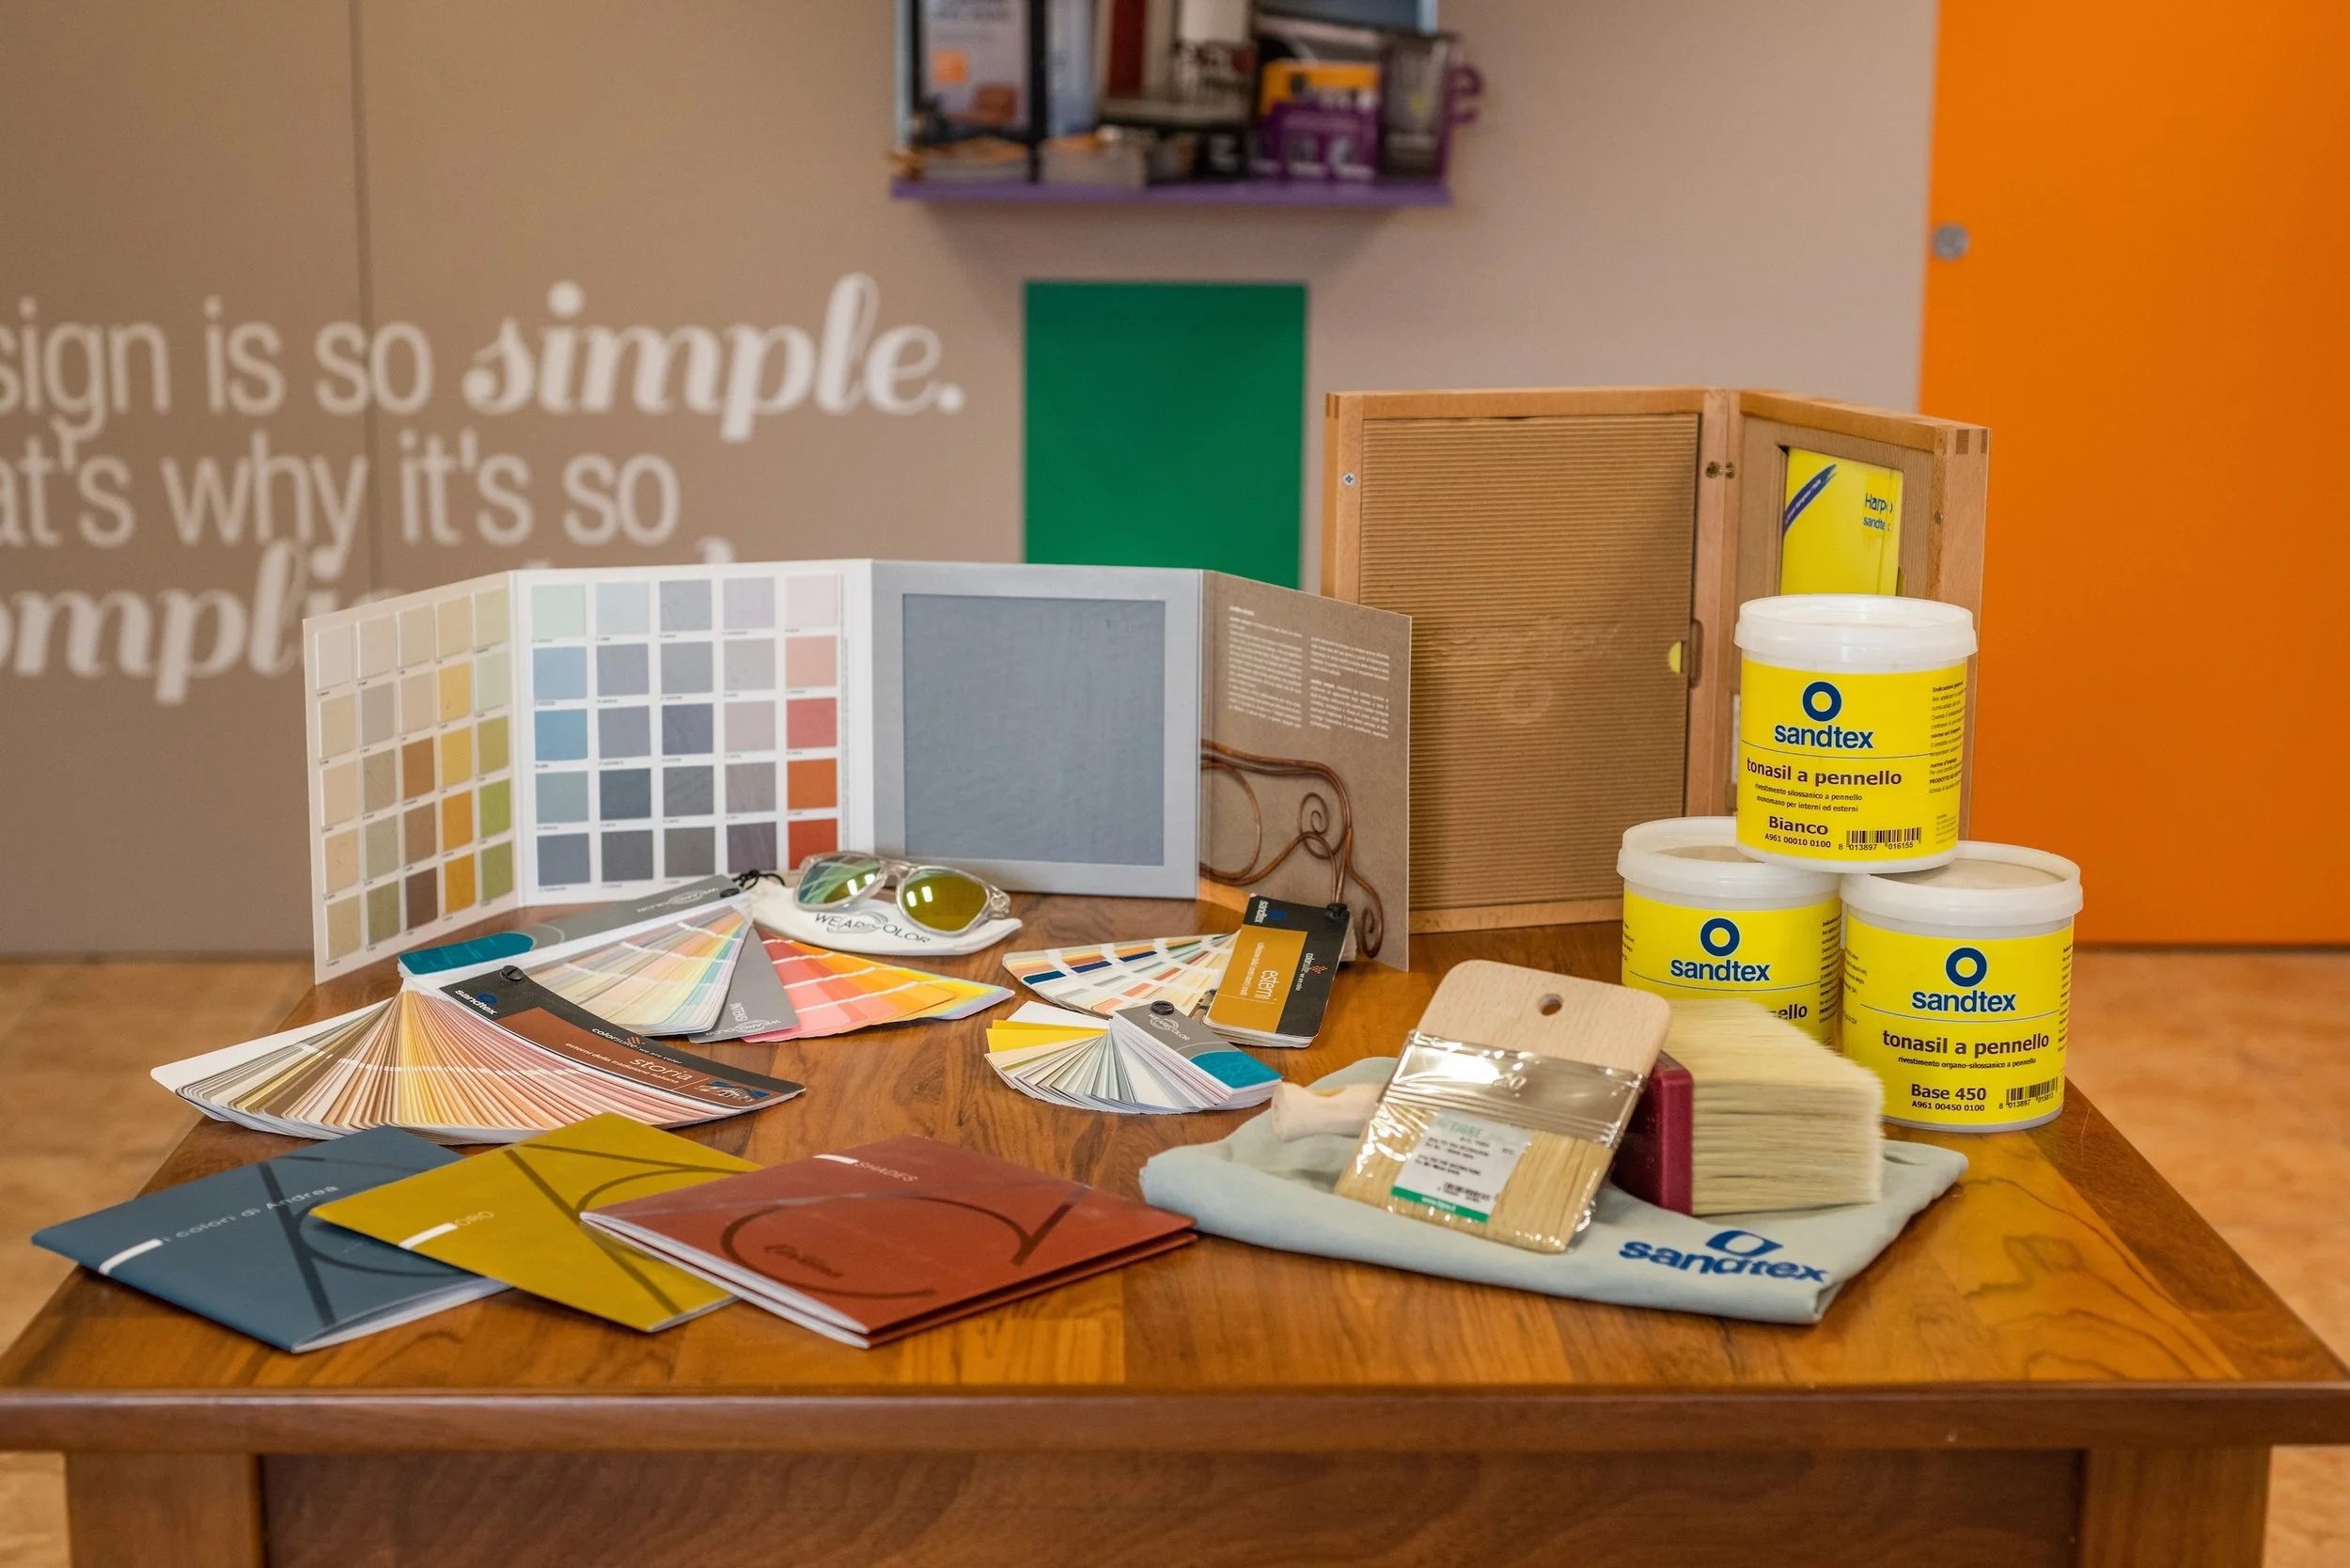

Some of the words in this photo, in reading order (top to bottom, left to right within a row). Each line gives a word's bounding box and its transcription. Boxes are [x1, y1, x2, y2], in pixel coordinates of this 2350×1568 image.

[206, 296, 284, 416] is
[315, 321, 434, 416] so
[462, 273, 965, 442] simple.
[162, 429, 368, 578] why
[399, 428, 535, 547] it's
[562, 453, 681, 547] so
[1774, 724, 1874, 749] sandtex
[1747, 757, 1792, 780] tonasil
[1797, 770, 1809, 783] a
[1814, 770, 1903, 787] pennello
[1787, 790, 1823, 799] silossanico
[1798, 802, 1821, 810] interni
[1769, 815, 1829, 835] Bianco
[1764, 833, 1781, 842] A961
[1783, 837, 1808, 846] 00010
[1810, 839, 1831, 848] 0100
[1670, 959, 1770, 982] sandtex
[455, 990, 498, 1015] sandtex
[1912, 989, 2016, 1013] sandtex
[1882, 1029, 1948, 1053] tonasil
[1954, 1042, 1966, 1055] a
[1974, 1032, 2049, 1058] pennello
[629, 1058, 693, 1081] storia
[1898, 1056, 1940, 1068] rivestimento
[1941, 1061, 2005, 1070] organo-silossanico
[2012, 1058, 2036, 1068] pennello
[1911, 1083, 1950, 1100] Base
[1955, 1088, 1987, 1101] 450
[2008, 1099, 2031, 1108] 013897
[1912, 1100, 1933, 1109] A961
[1935, 1103, 1962, 1111] 00450
[176, 1215, 236, 1238] colori
[266, 1185, 339, 1210] Andrea
